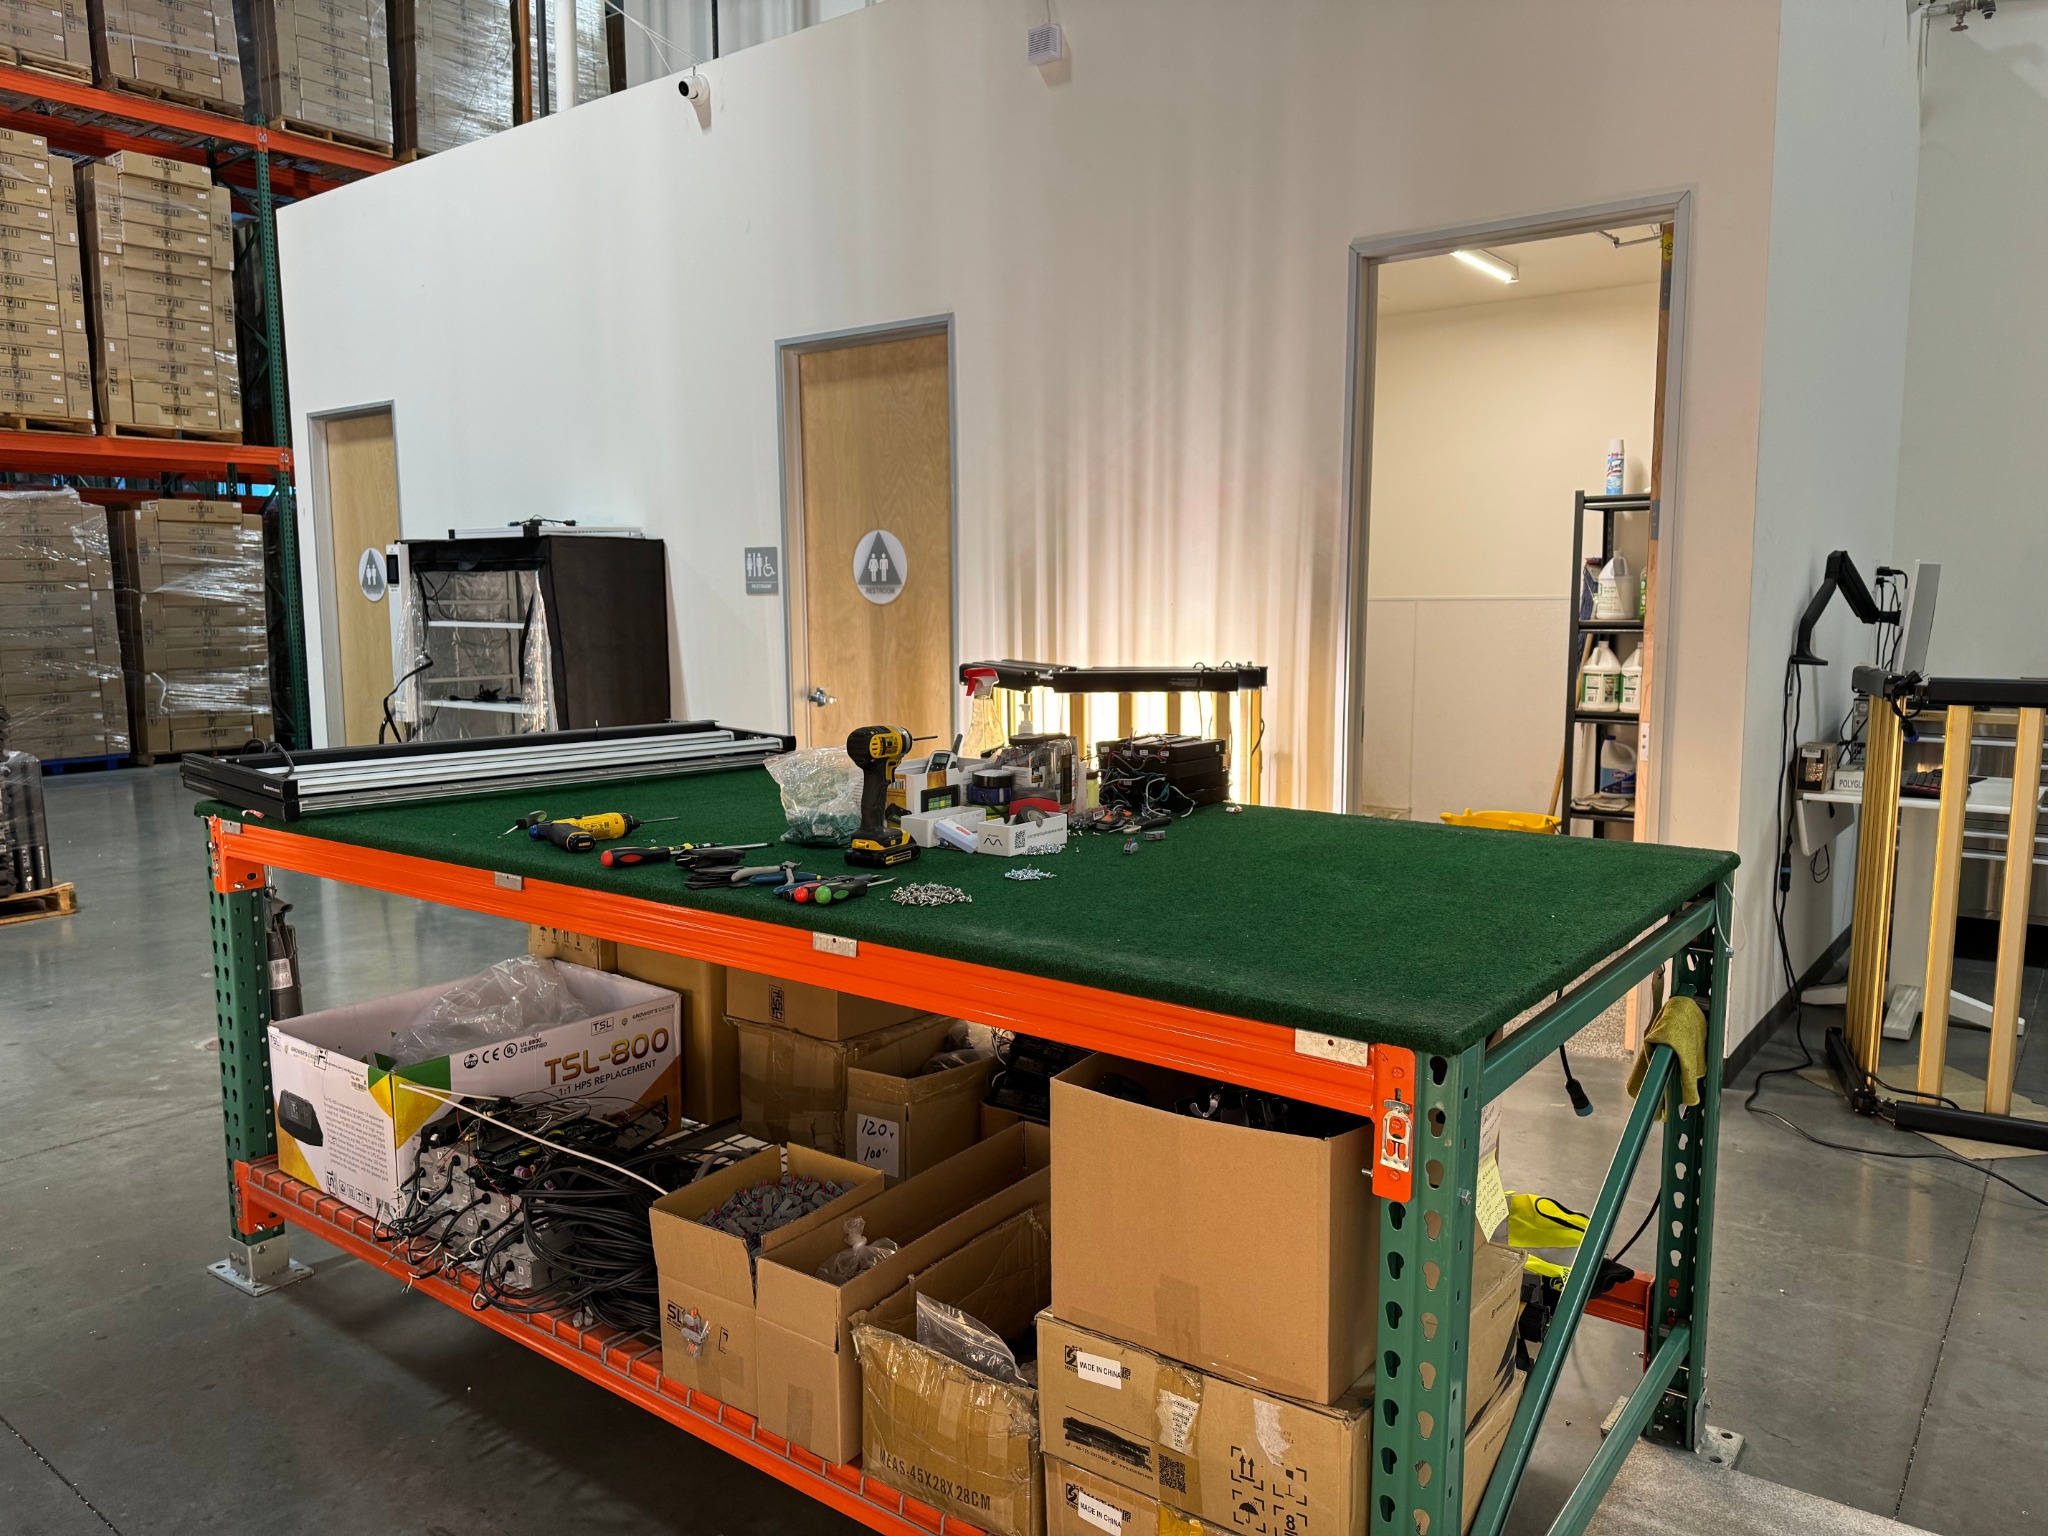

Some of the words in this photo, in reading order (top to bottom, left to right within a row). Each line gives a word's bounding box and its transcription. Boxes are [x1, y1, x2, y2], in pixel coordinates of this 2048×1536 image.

[865, 587, 896, 595] RESTROOM
[631, 1007, 658, 1020] GROWER'S
[592, 1020, 613, 1031] TSL
[520, 1041, 548, 1054] CERTIFIED
[544, 1028, 670, 1086] TSL-800
[558, 1085, 572, 1097] 1:1
[574, 1079, 592, 1092] HPS
[594, 1058, 657, 1086] REPLACEMENT
[1079, 1361, 1096, 1373] MADE
[1096, 1366, 1103, 1374] IN
[1103, 1368, 1122, 1379] CHINA
[1080, 1502, 1096, 1516] MADE
[1096, 1510, 1103, 1519] IN
[1103, 1514, 1122, 1529] CHINA
